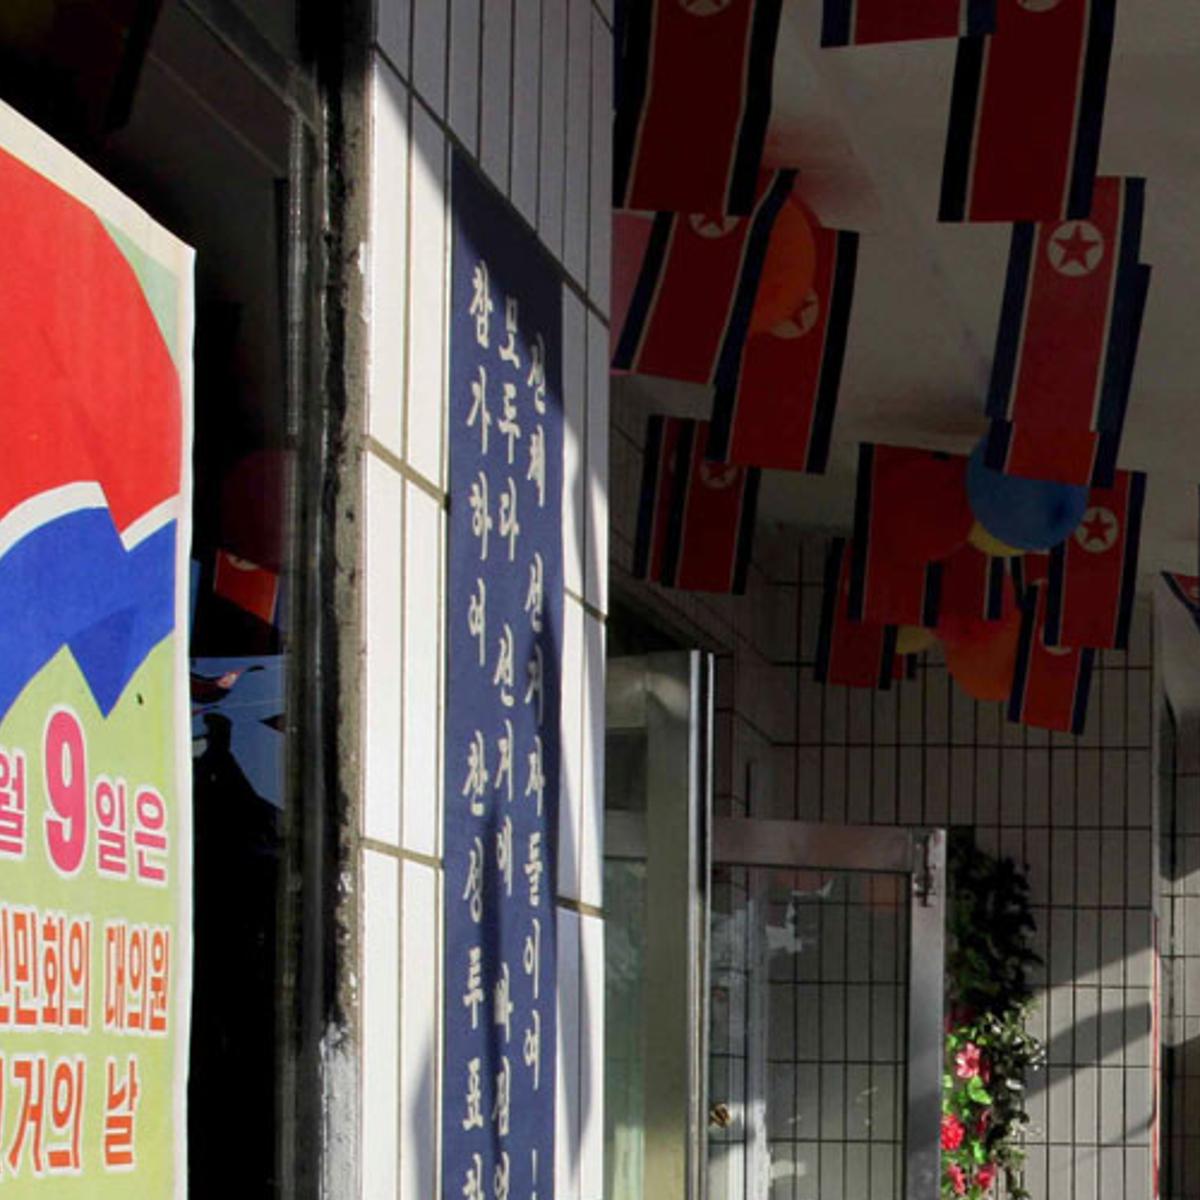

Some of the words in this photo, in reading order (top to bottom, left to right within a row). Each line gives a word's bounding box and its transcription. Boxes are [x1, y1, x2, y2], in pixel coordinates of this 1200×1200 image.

[466, 258, 493, 666] 참가하여
[526, 331, 546, 508] 전체
[493, 622, 514, 897] 선거에
[105, 924, 168, 1030] 대의원
[0, 1057, 85, 1172] 거의
[105, 1060, 137, 1166] 날
